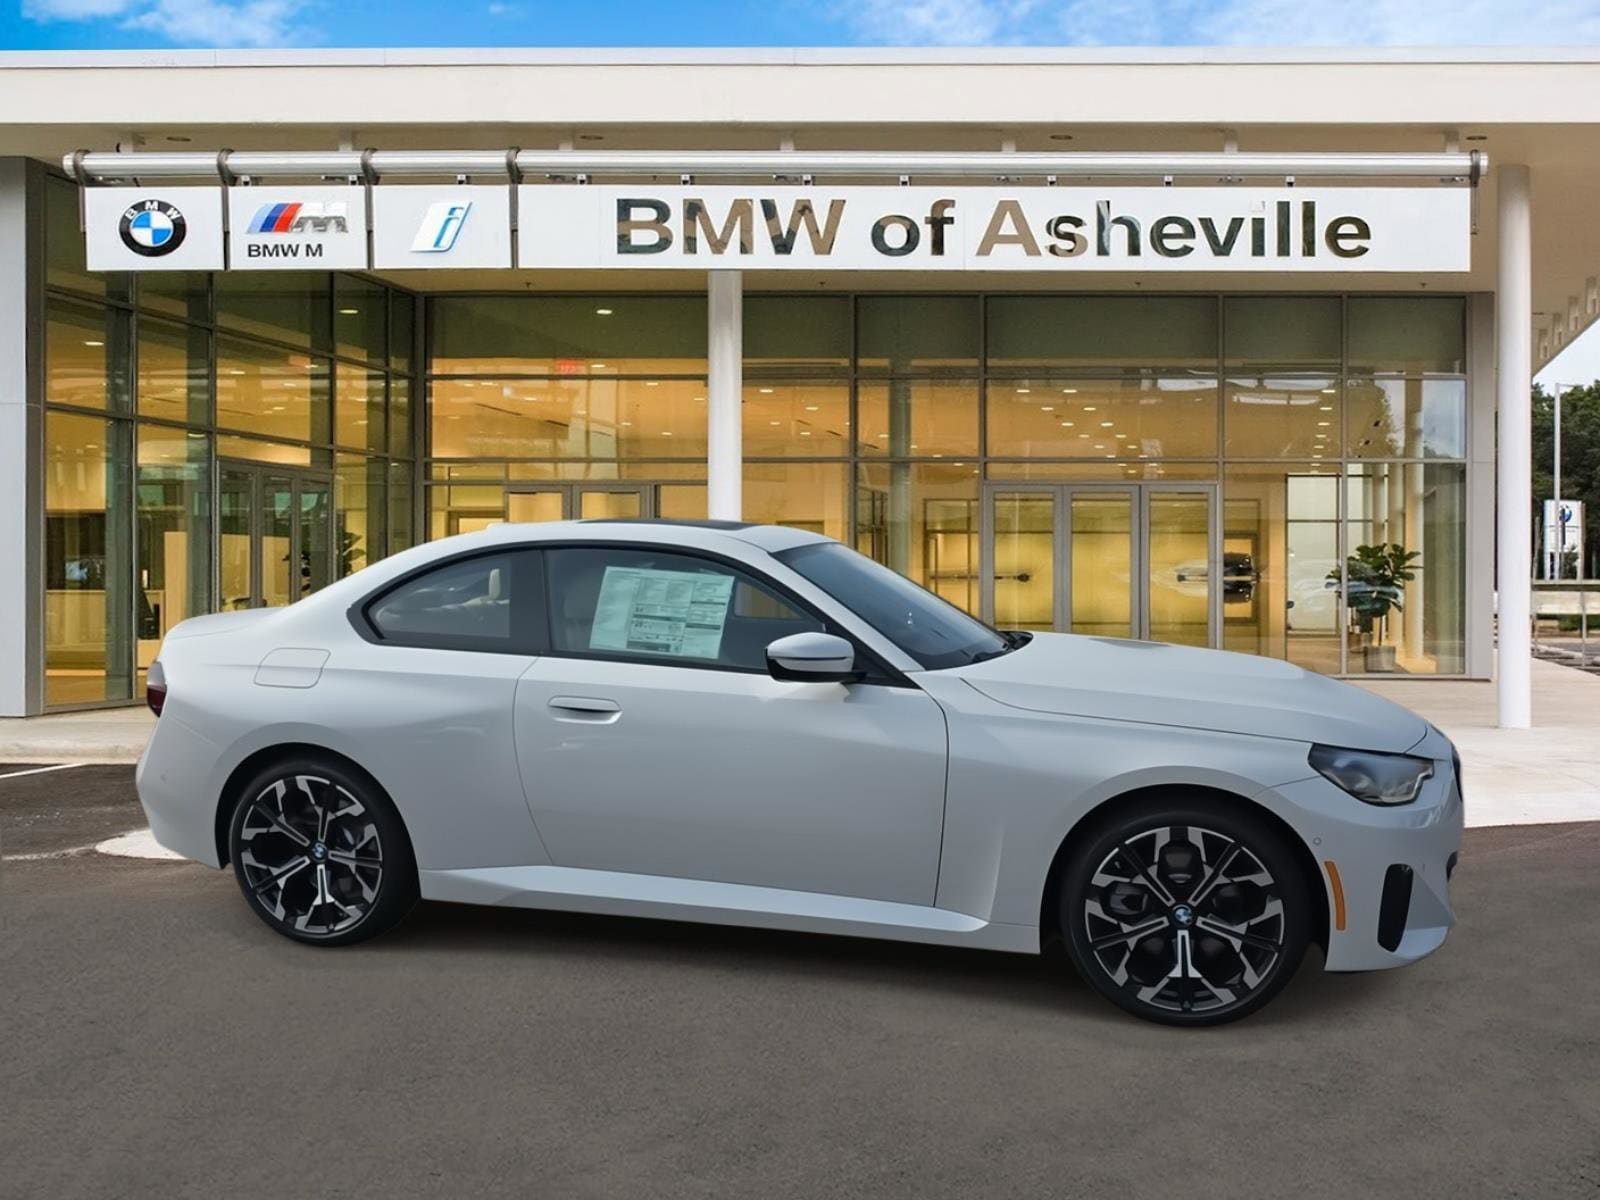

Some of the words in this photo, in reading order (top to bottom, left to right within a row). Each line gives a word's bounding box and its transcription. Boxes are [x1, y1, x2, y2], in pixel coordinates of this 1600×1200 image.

[125, 200, 181, 220] BMW
[615, 198, 847, 256] BMW
[870, 198, 957, 257] of
[975, 199, 1372, 258] Asheville
[247, 243, 300, 258] BMW
[305, 243, 323, 258] M
